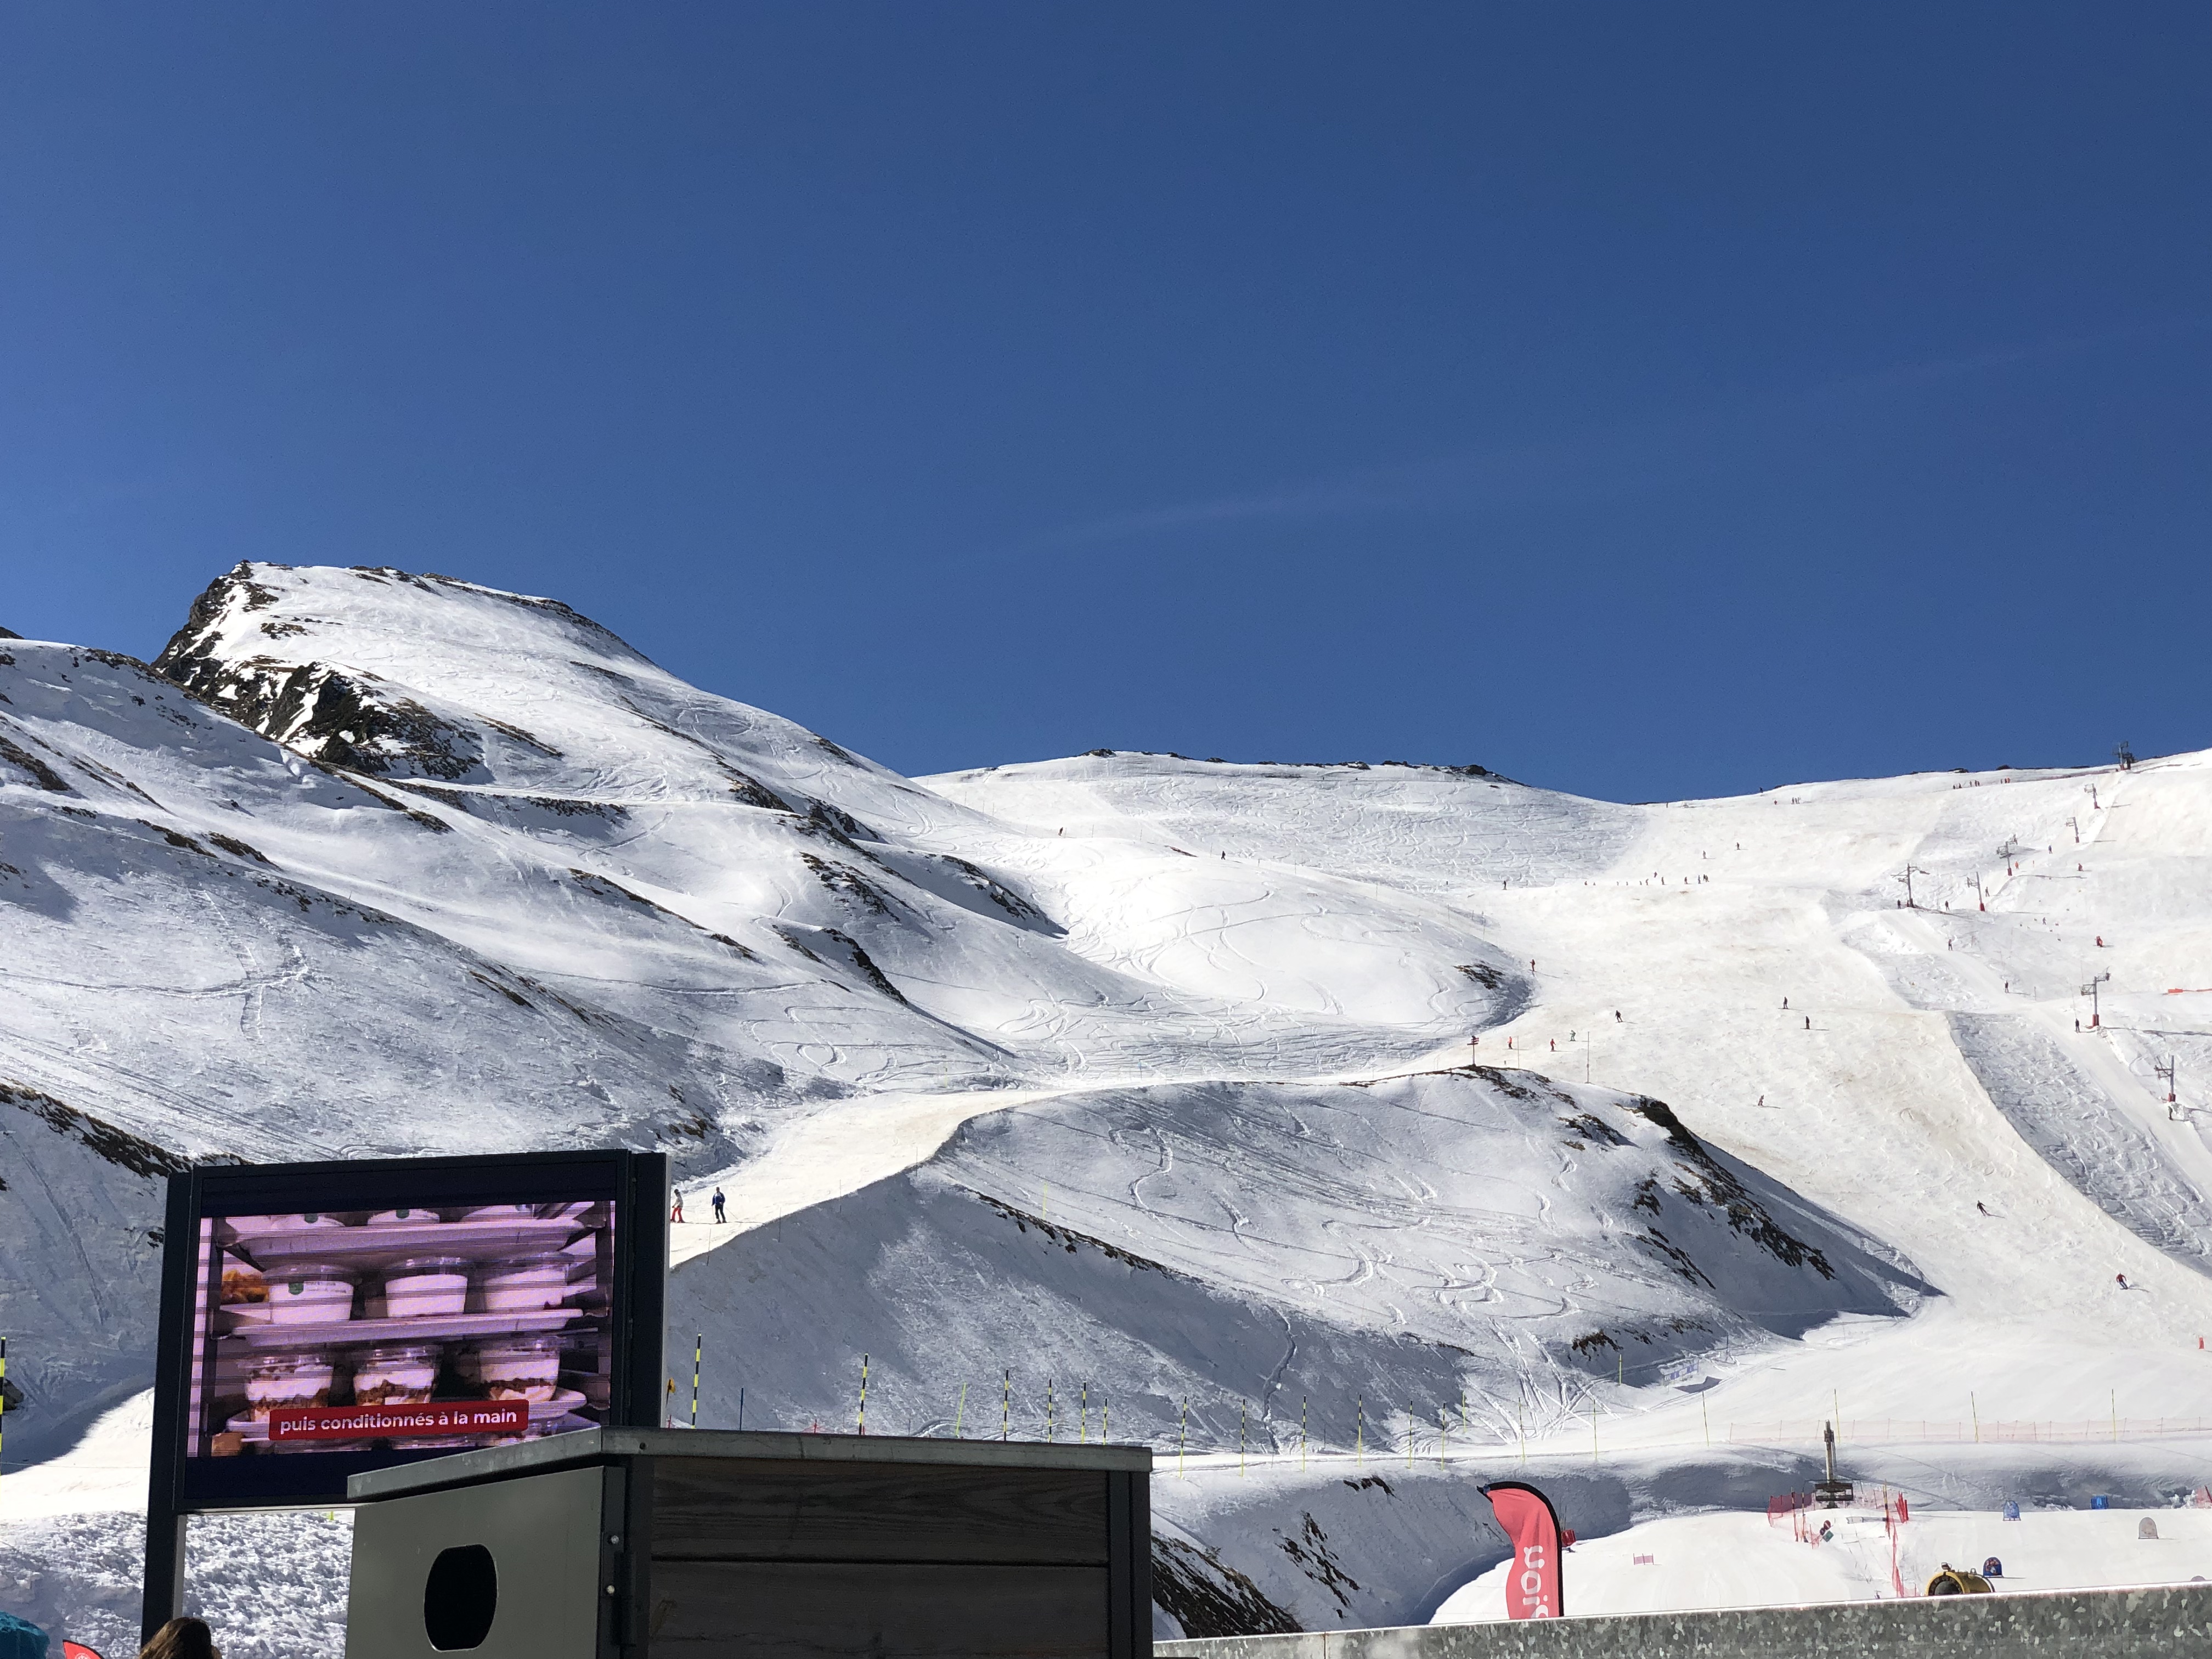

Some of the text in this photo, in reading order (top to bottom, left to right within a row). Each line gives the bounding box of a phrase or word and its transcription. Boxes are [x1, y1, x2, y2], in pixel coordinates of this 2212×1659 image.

[280, 1408, 517, 1435] puis conditionnés à la main
